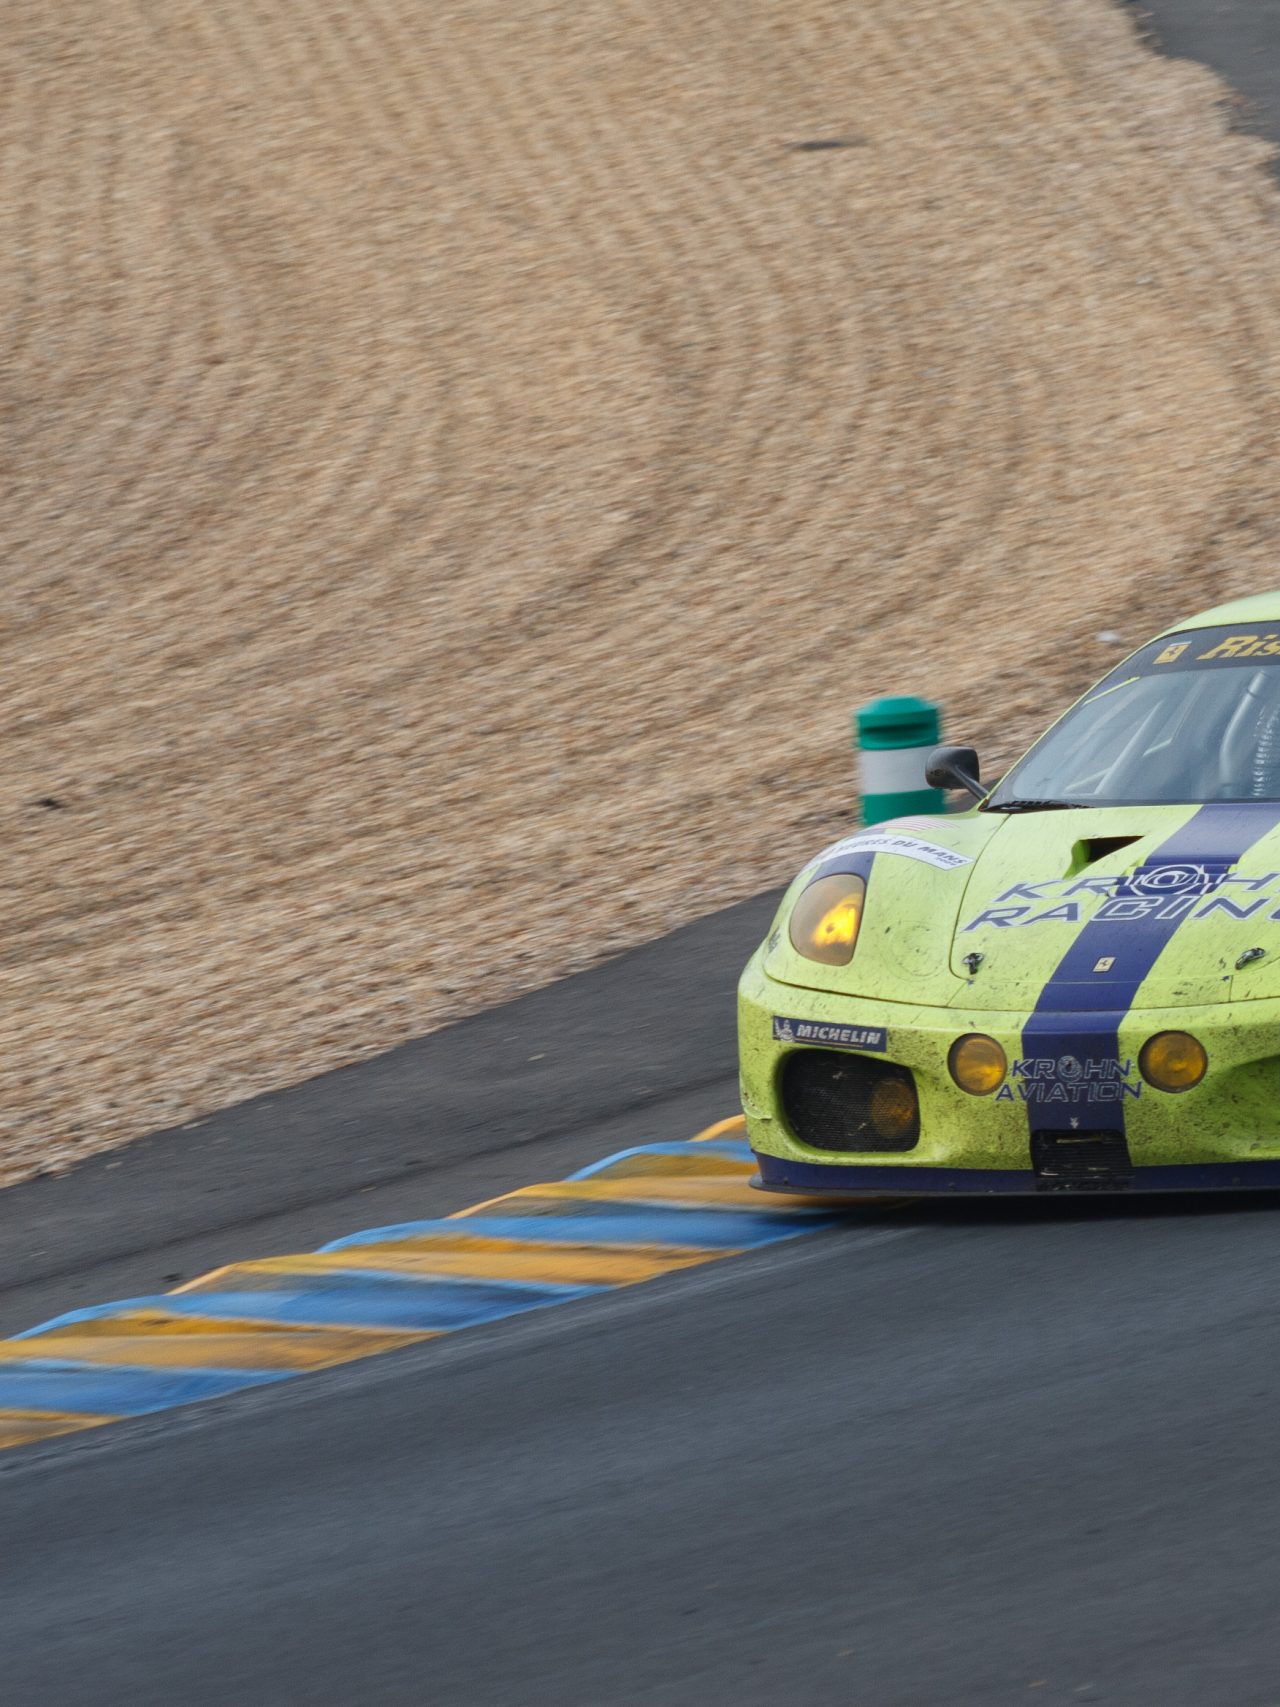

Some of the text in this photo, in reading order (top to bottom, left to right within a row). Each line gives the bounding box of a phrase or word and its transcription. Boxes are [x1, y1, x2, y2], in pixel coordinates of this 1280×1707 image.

[891, 839, 918, 849] DU
[918, 845, 968, 864] MANS
[796, 1024, 881, 1045] MICHELIN
[1011, 1055, 1132, 1083] KROHN
[995, 1080, 1143, 1103] AVIATION
